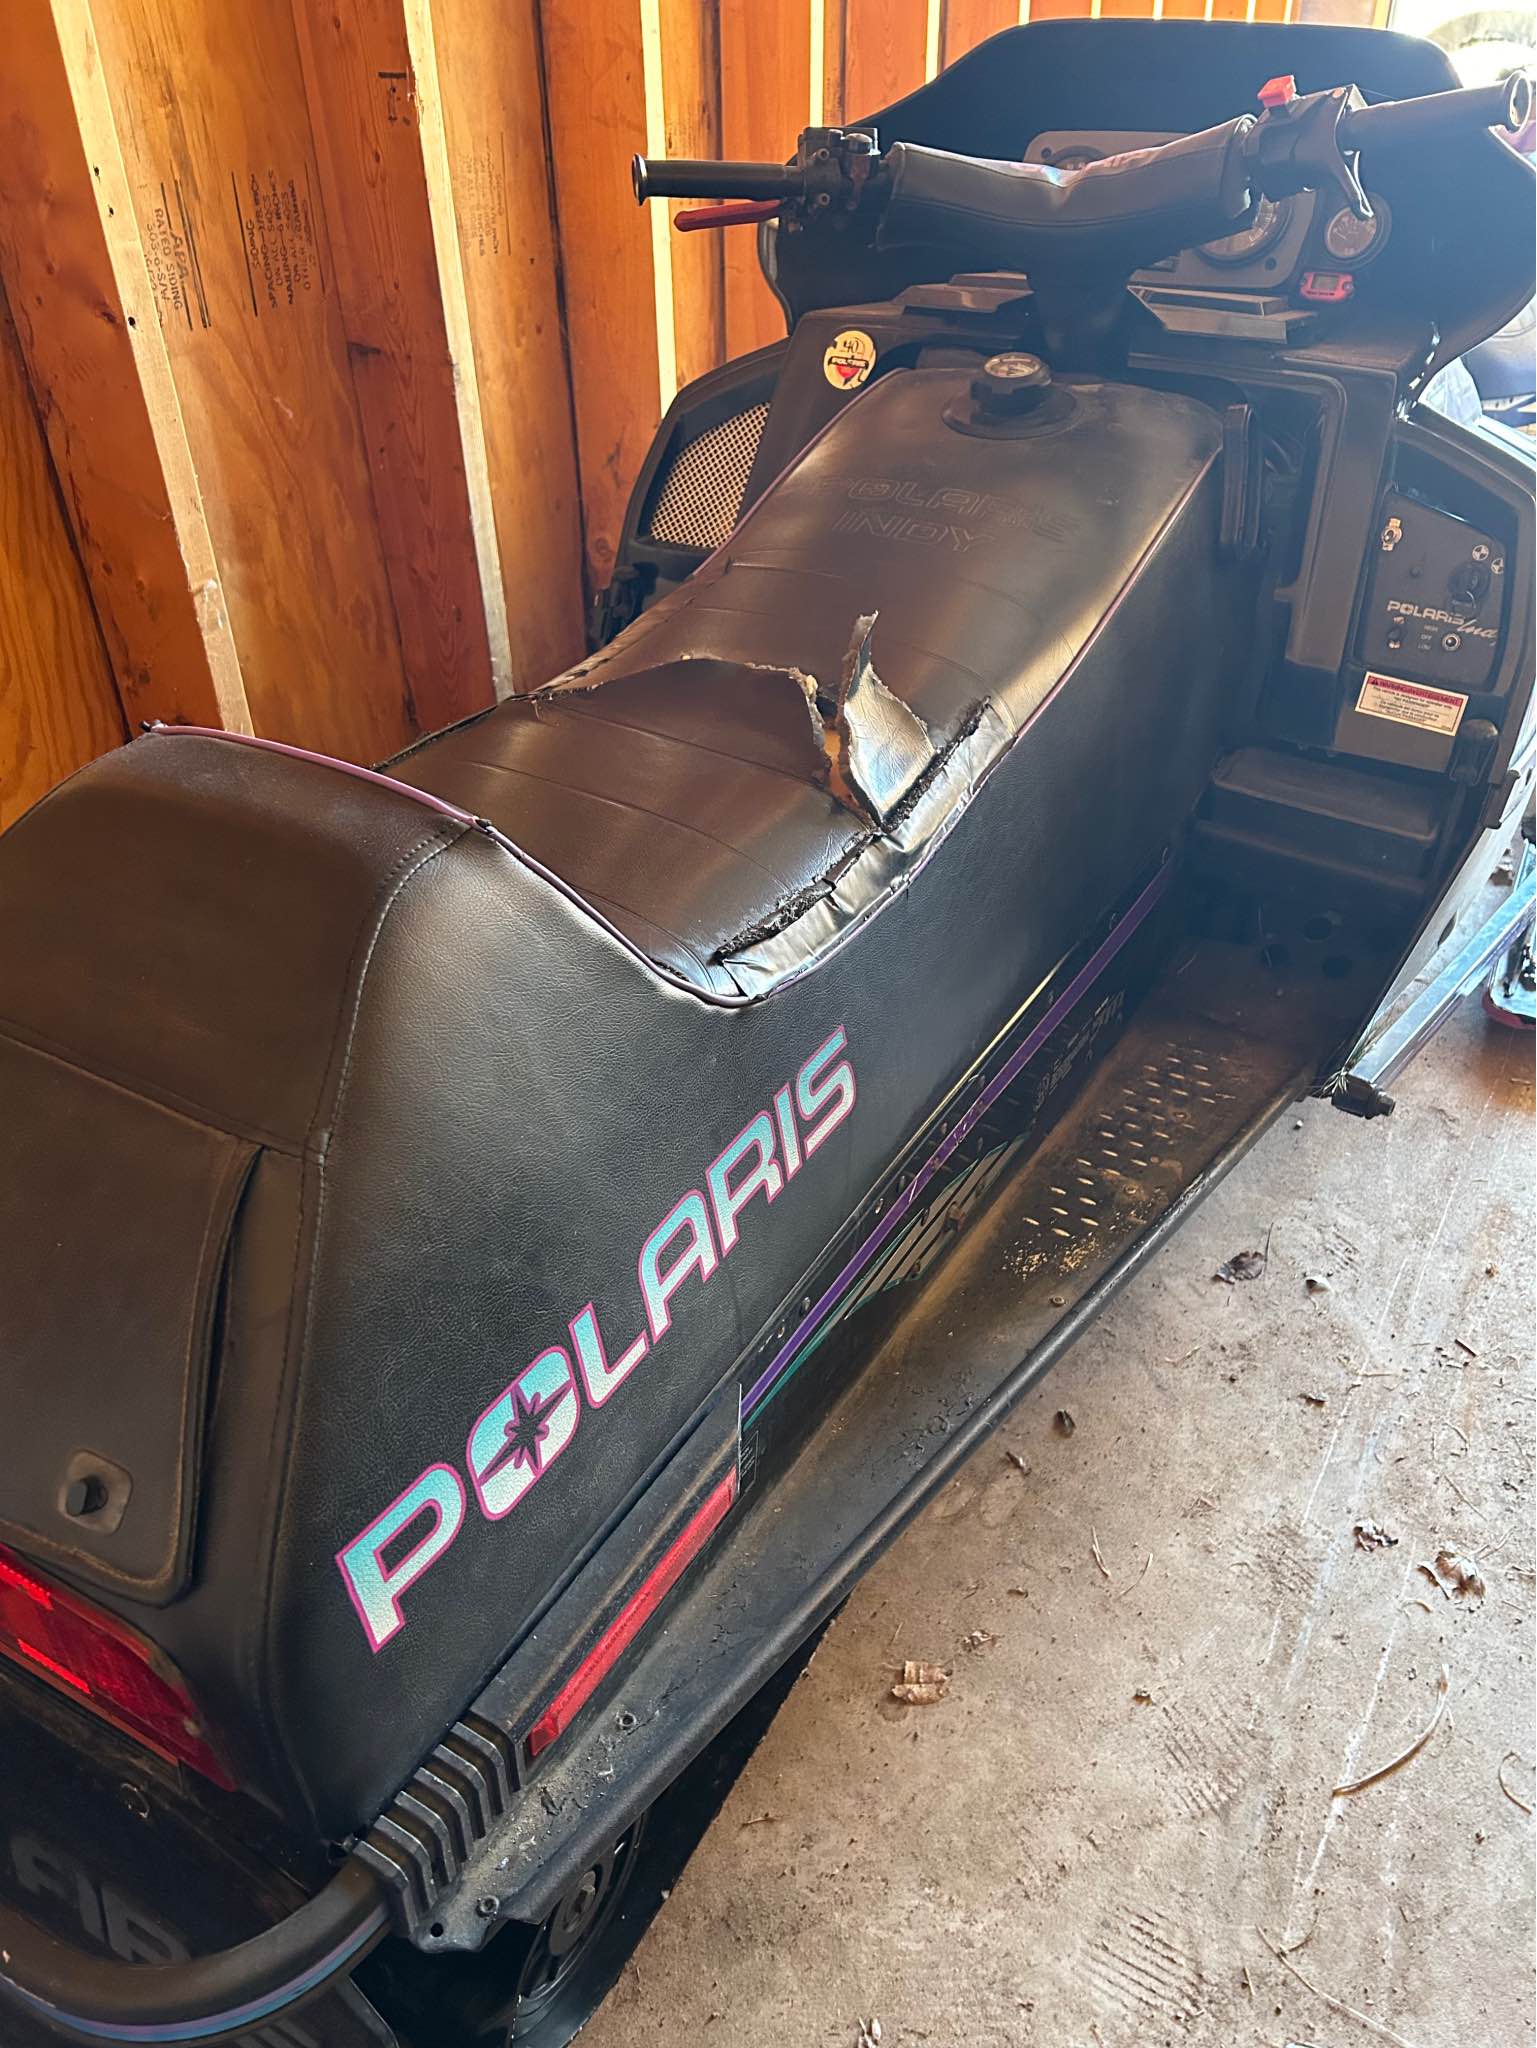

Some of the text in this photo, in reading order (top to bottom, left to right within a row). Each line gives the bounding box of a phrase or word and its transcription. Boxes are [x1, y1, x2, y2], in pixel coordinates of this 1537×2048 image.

[154, 207, 172, 257] RATED
[166, 263, 183, 311] SIDING
[171, 231, 190, 281] APA
[832, 511, 996, 553] INDY
[1386, 600, 1465, 626] POLARIS
[335, 1024, 857, 1654] POLARIS
